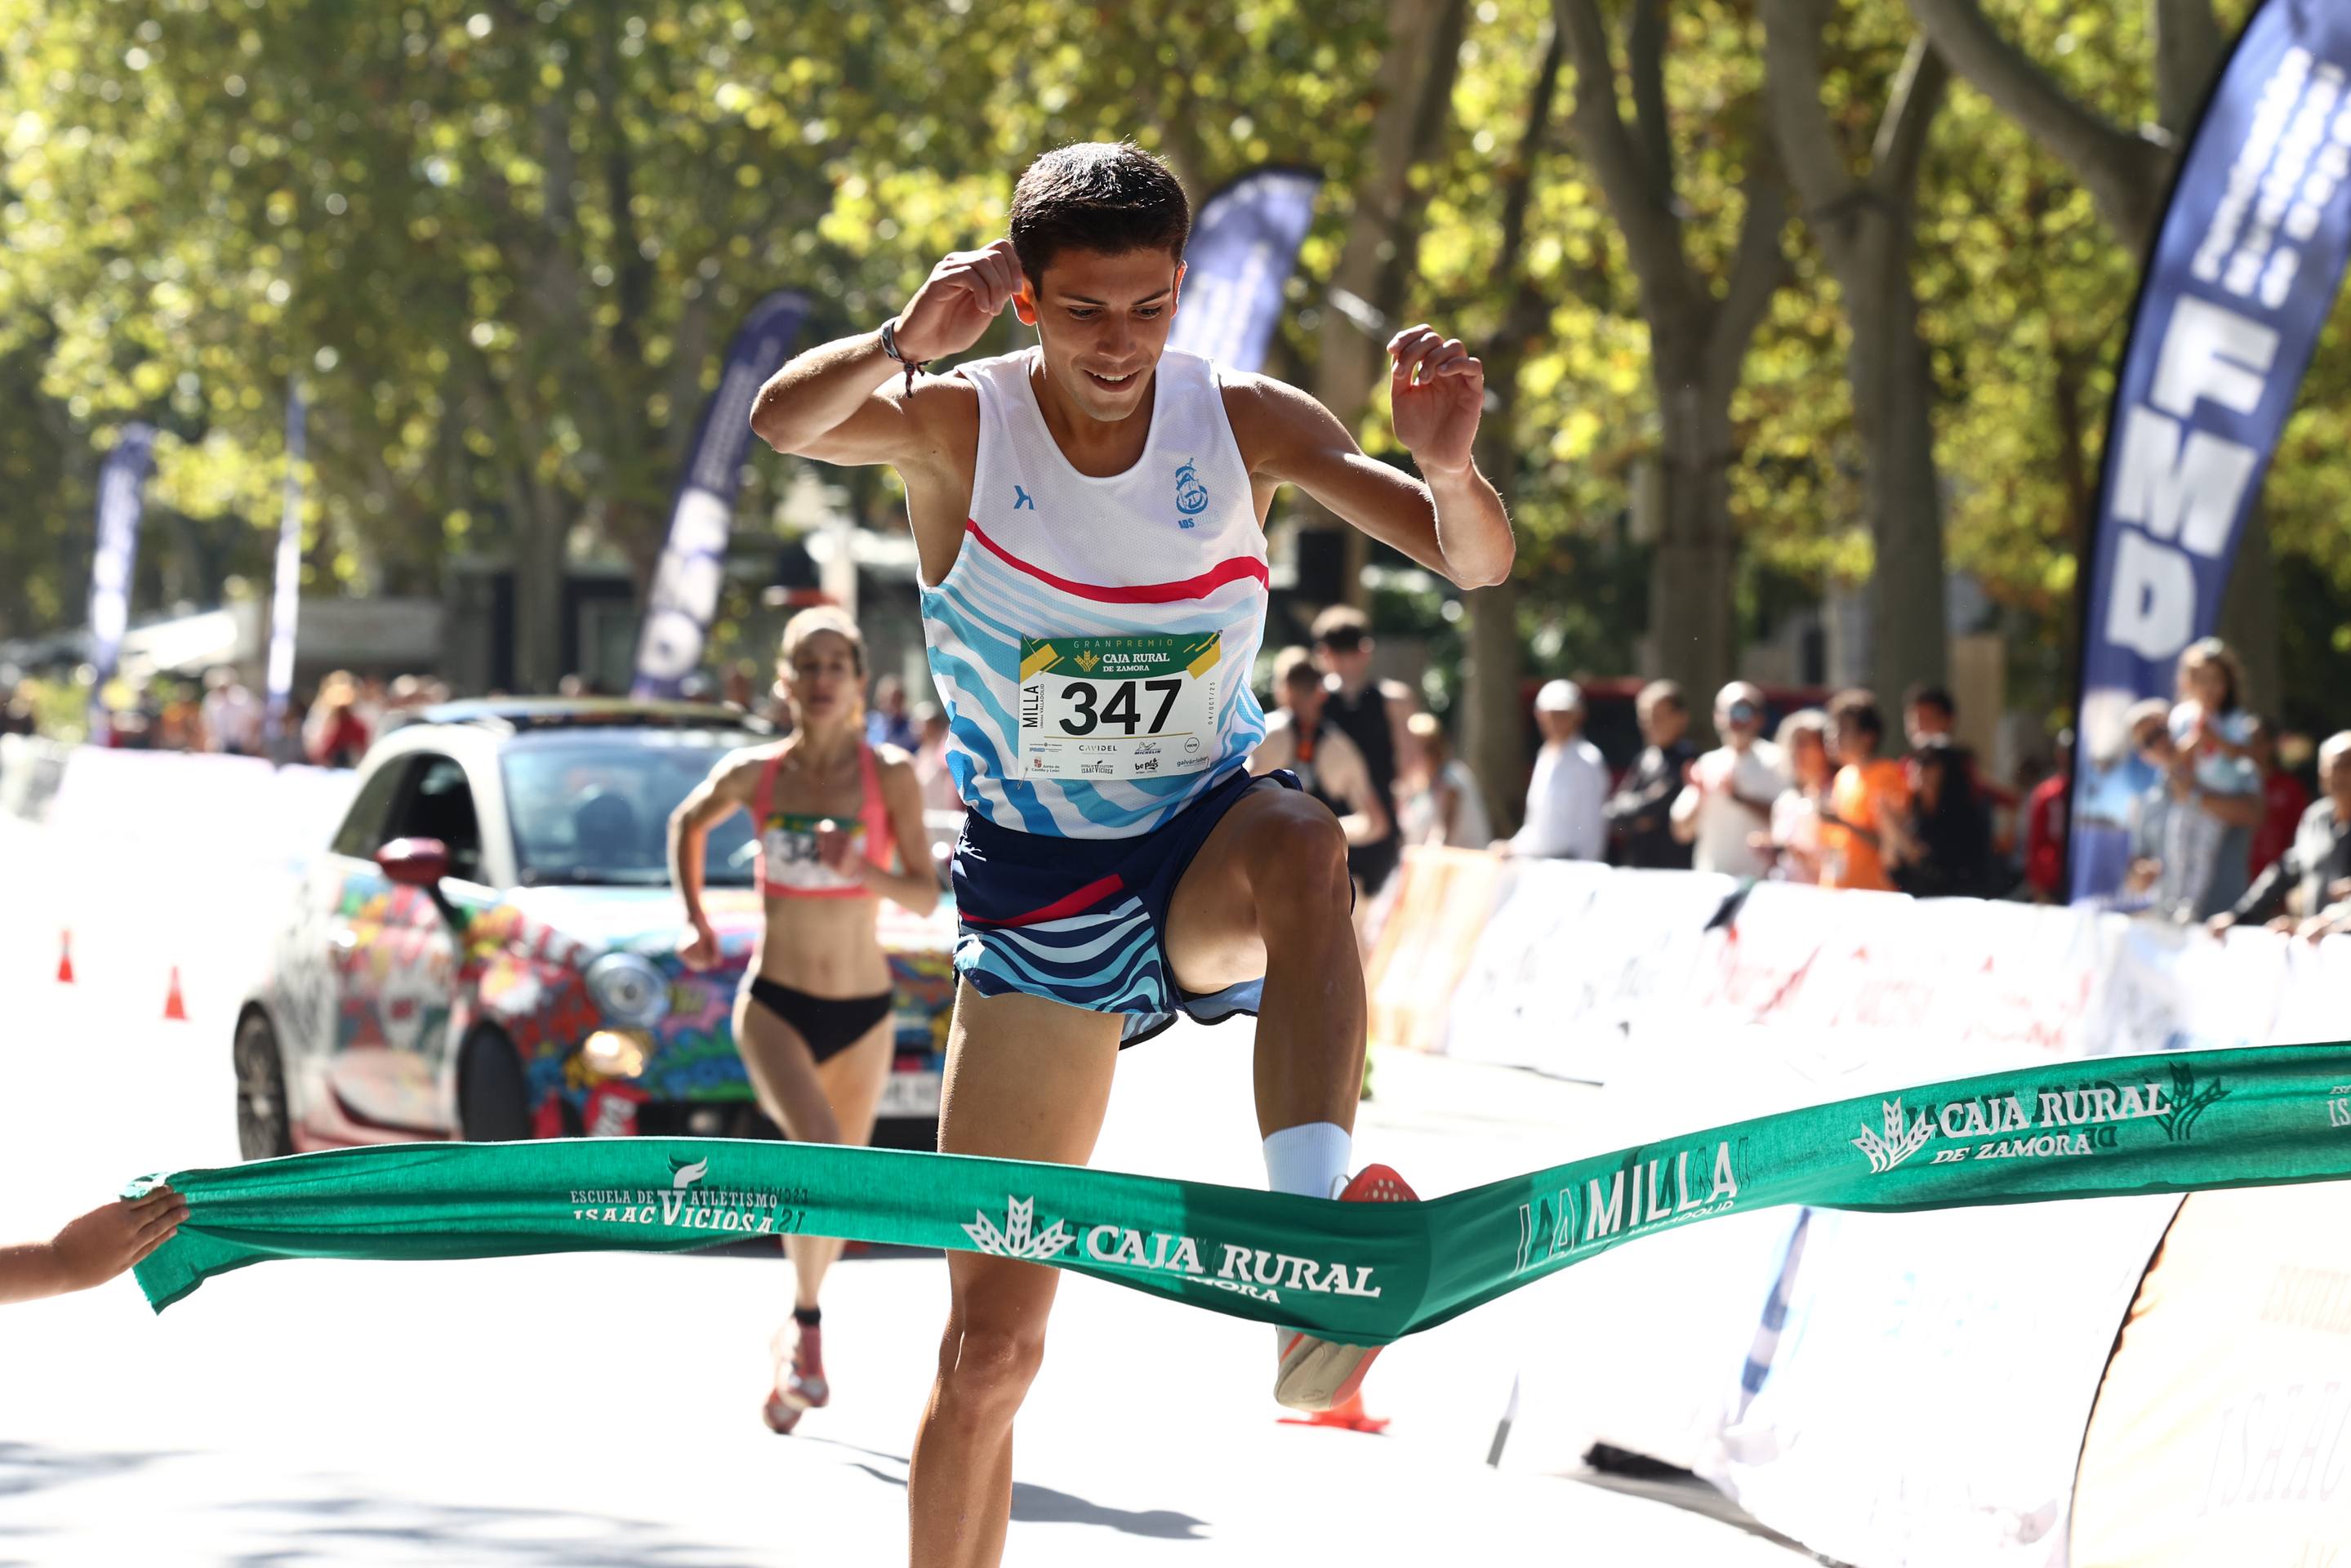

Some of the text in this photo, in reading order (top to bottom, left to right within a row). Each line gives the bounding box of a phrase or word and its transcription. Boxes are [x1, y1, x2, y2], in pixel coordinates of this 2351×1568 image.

[1102, 653, 1170, 664] CAJA RURAL
[1022, 685, 1039, 728] MILLA
[1059, 679, 1182, 736] 347
[1940, 1084, 2171, 1138] CAJA RURAL
[1929, 1134, 2093, 1165] DE ZAMORA
[571, 1190, 777, 1209] ESCUELA DE ATLETISMO
[573, 1206, 657, 1225] ISAAC
[657, 1190, 775, 1233] VICIOSA
[1586, 1142, 1737, 1241] MILLA
[1086, 1225, 1382, 1298] CAJA RURAL
